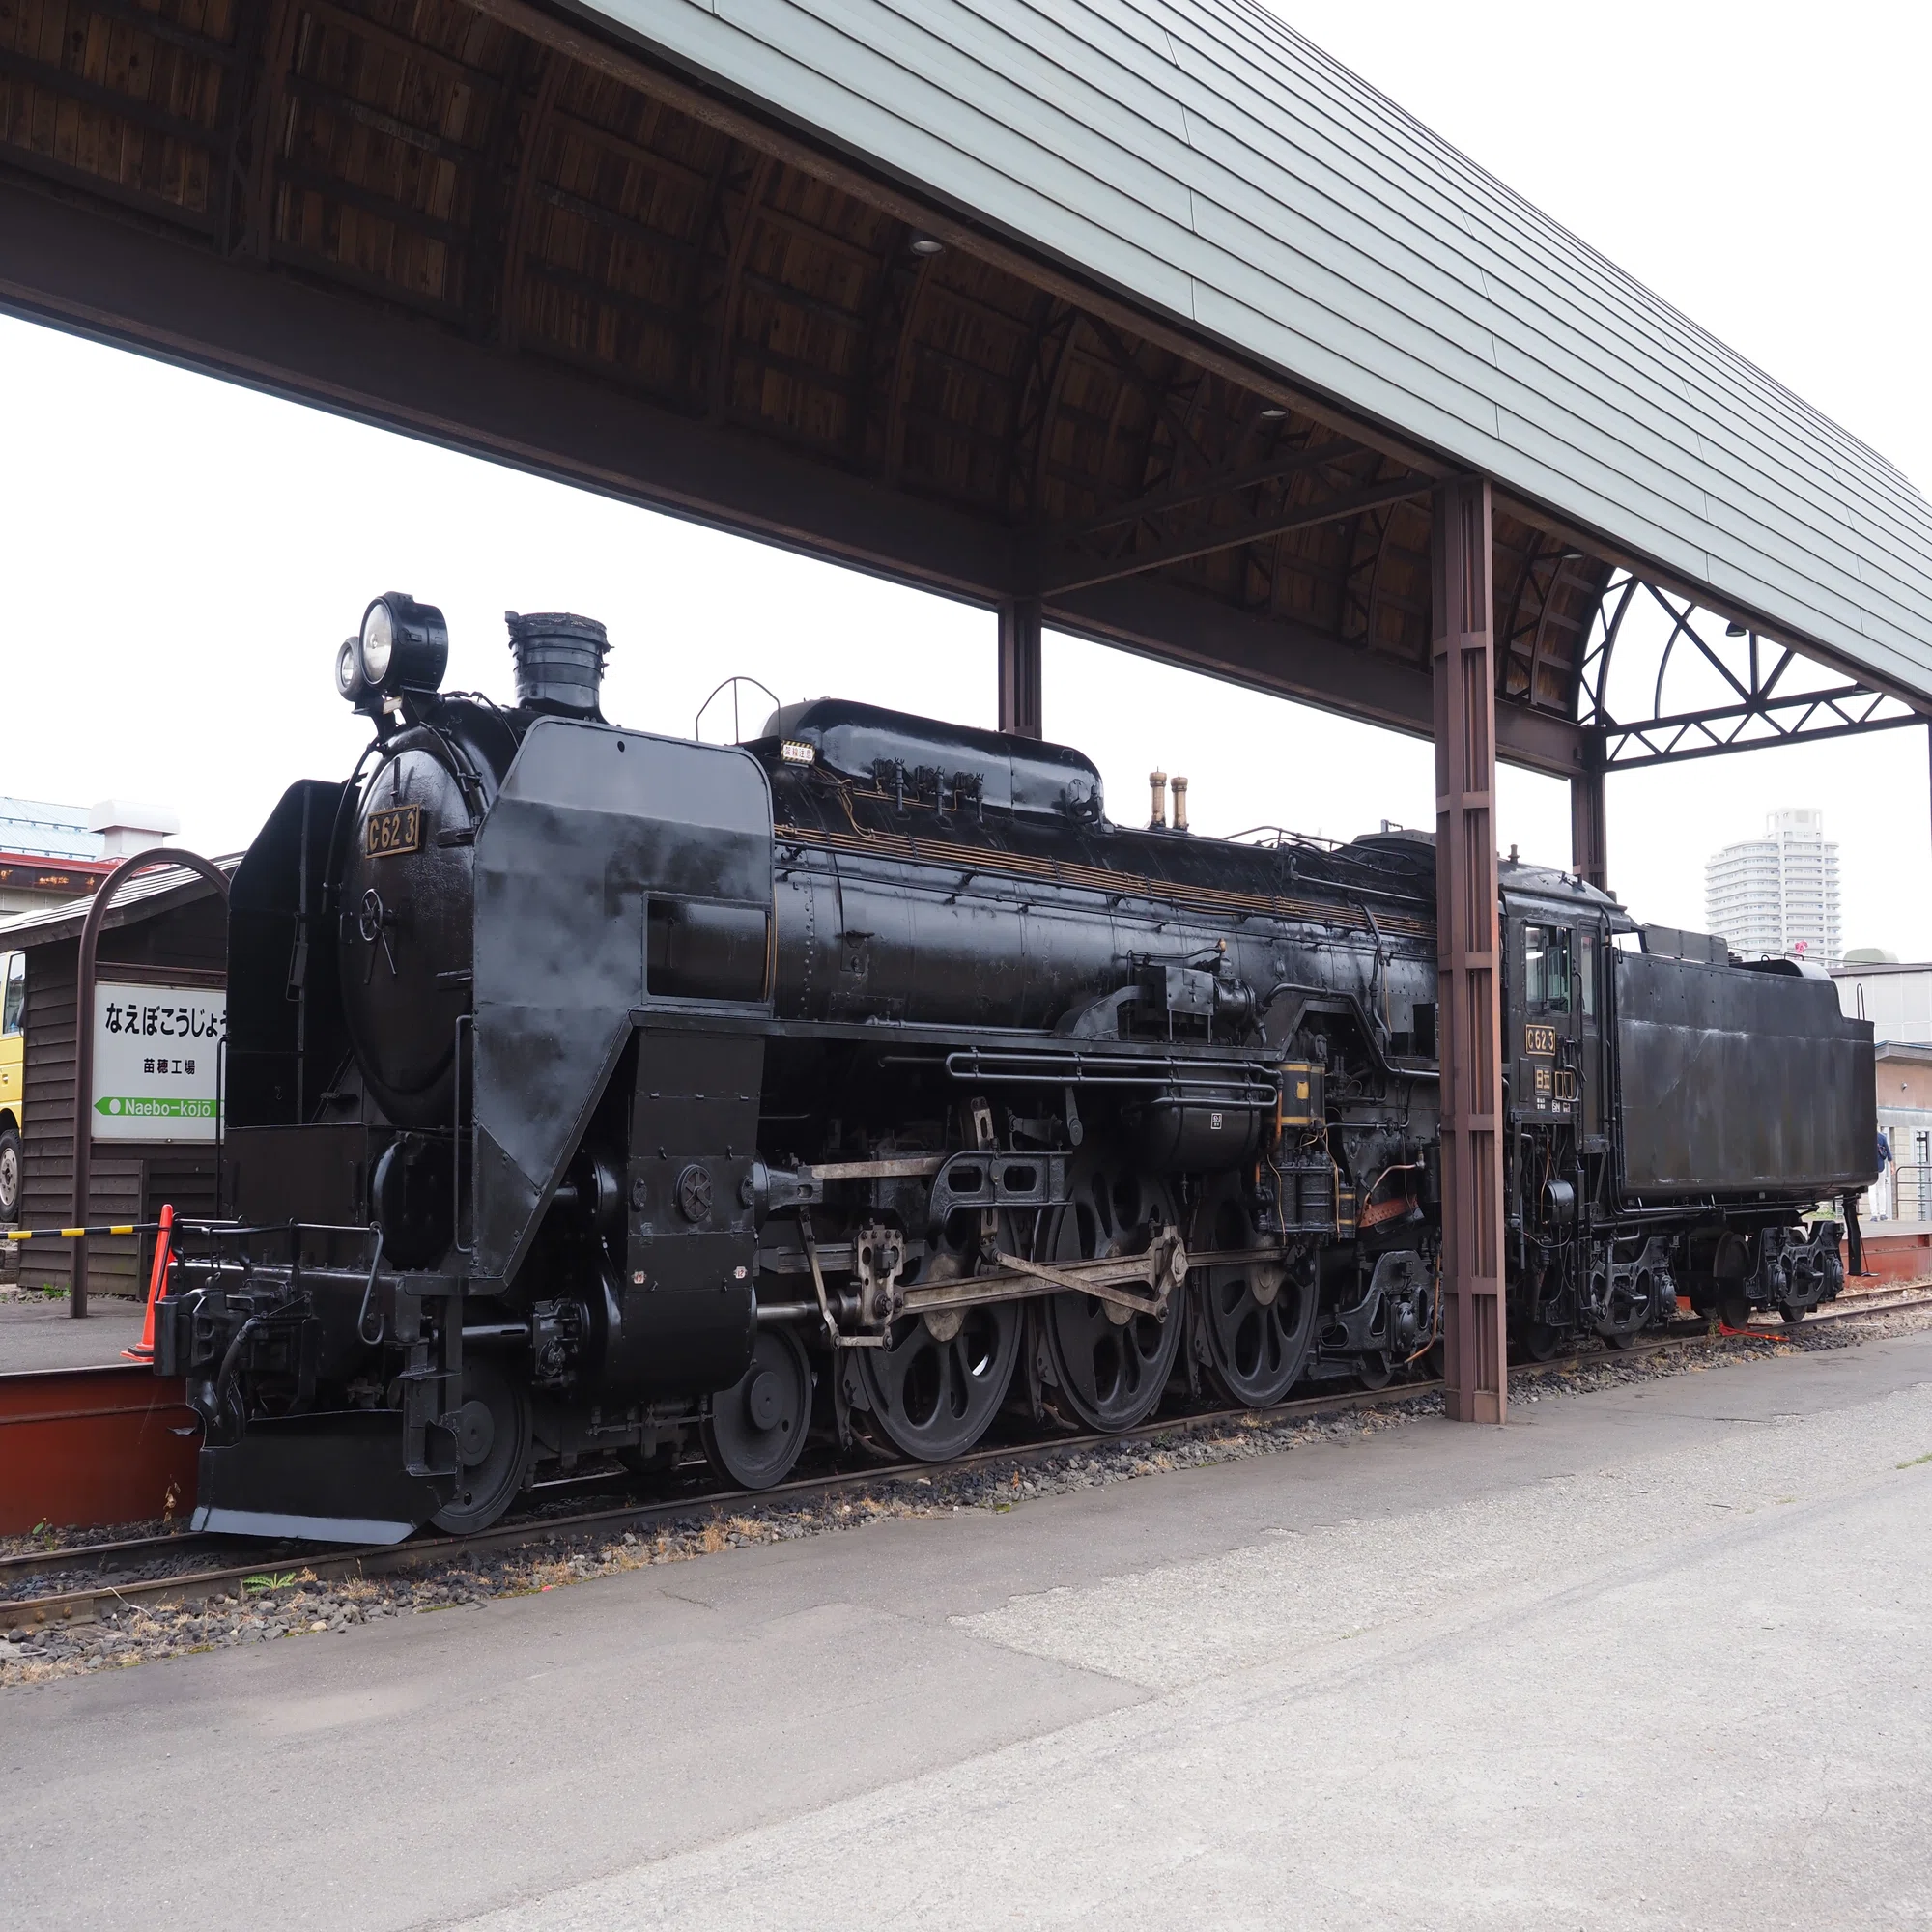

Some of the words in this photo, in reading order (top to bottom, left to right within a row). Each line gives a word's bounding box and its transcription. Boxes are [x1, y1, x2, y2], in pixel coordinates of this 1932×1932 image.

[369, 813, 401, 851] C62
[405, 811, 415, 844] 3
[1527, 1029, 1547, 1050] C62
[1548, 1031, 1554, 1051] 3
[143, 1058, 196, 1075] 苗穂工場
[1536, 1069, 1550, 1090] 日立
[125, 1098, 211, 1117] Naebo-kōjō
